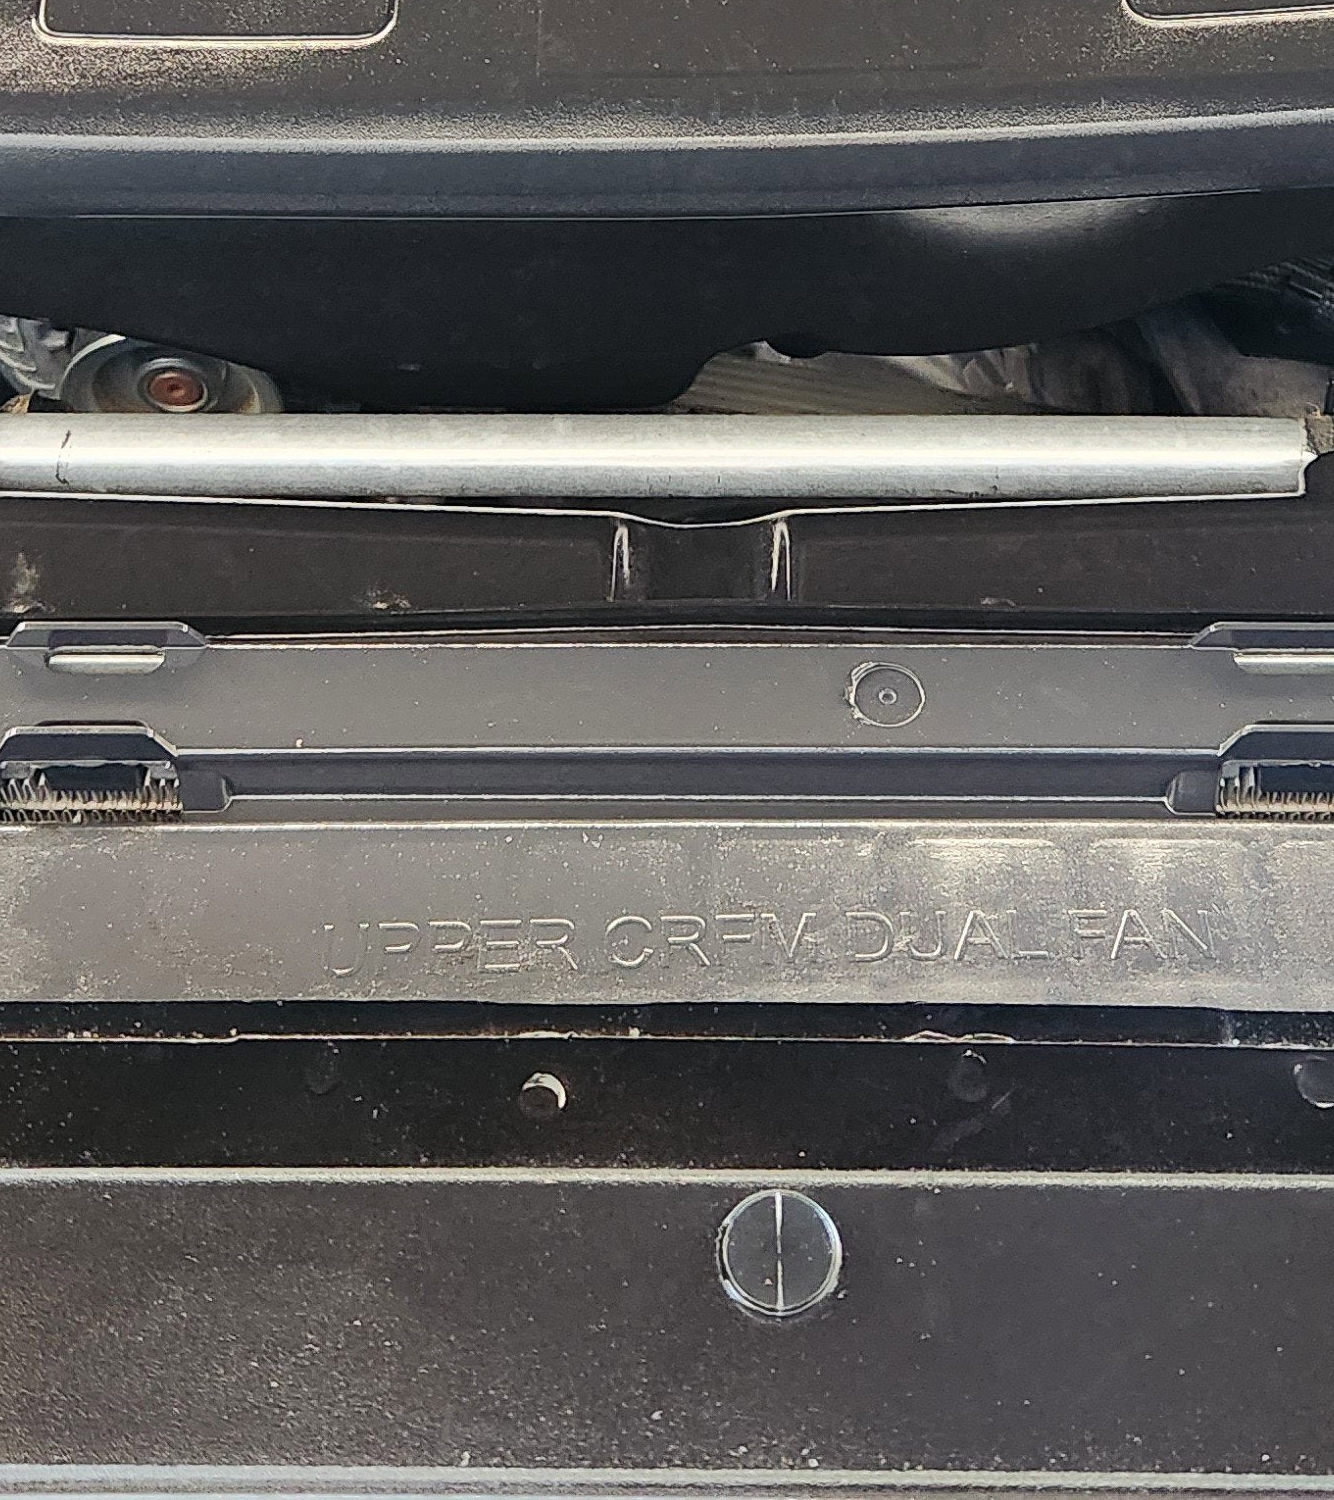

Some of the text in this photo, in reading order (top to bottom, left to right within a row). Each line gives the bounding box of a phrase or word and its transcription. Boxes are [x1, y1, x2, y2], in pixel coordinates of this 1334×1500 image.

[322, 916, 579, 977] UPPER
[844, 908, 1051, 962] DUAL
[1067, 908, 1217, 961] FAN
